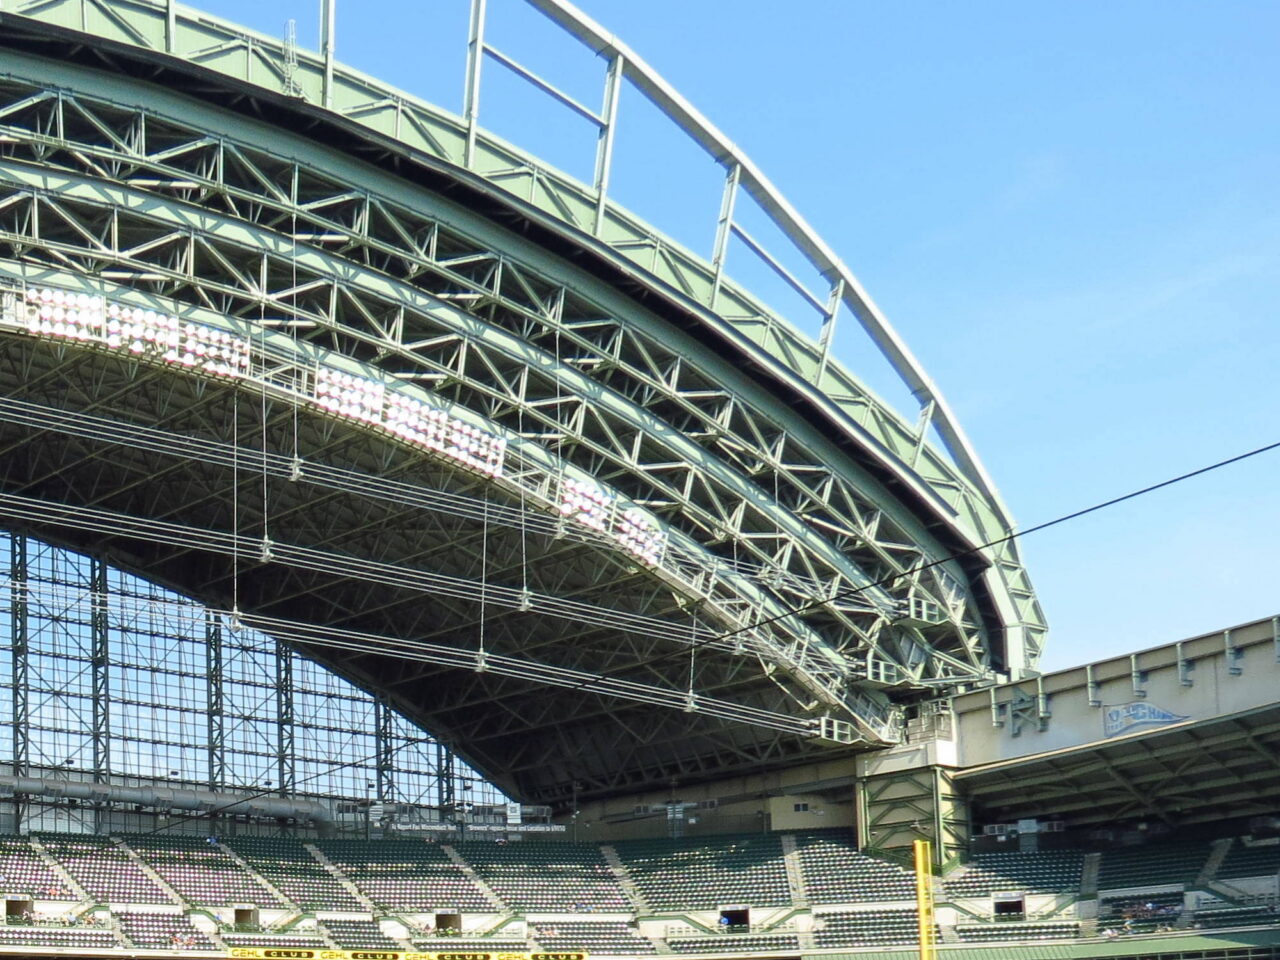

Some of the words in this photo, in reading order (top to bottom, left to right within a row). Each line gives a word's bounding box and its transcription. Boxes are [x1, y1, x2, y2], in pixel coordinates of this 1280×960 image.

[232, 949, 261, 958] GEHL
[321, 951, 349, 960] GEHL
[405, 953, 433, 960] GEHL
[497, 953, 528, 960] GEHL
